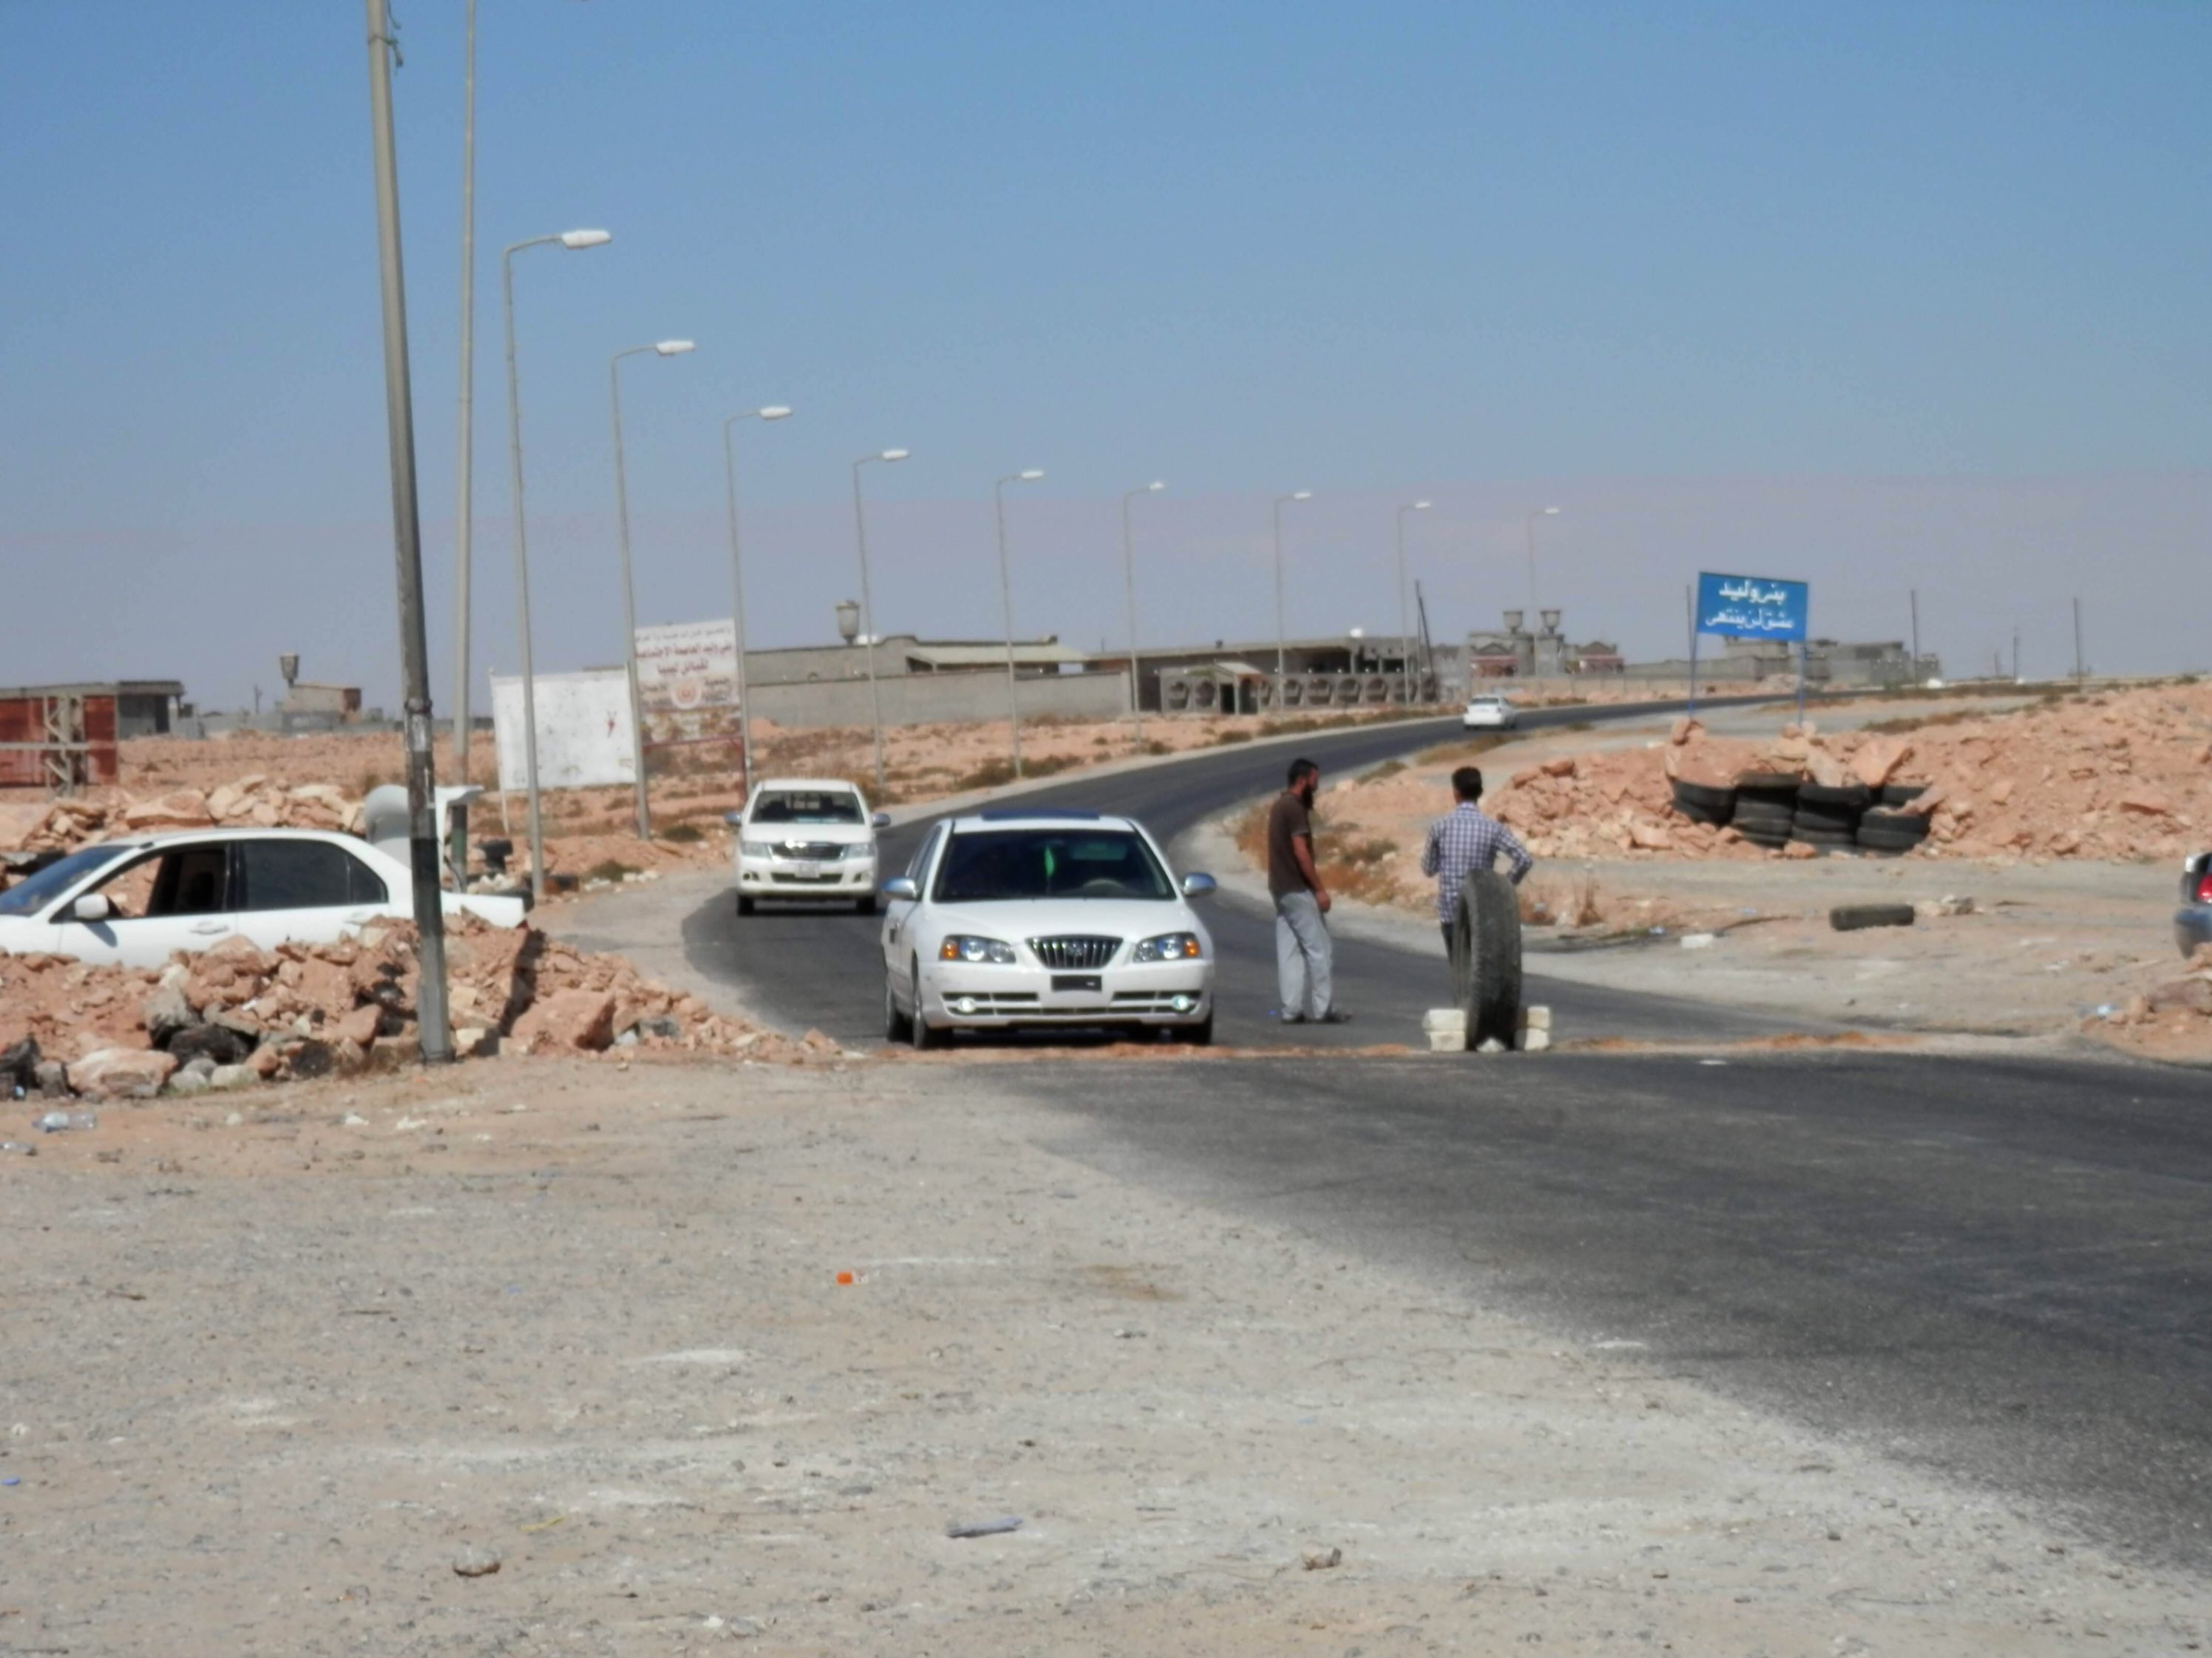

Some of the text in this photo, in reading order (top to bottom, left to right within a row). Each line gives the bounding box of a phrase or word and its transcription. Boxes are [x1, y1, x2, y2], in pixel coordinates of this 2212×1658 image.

[1719, 580, 1758, 603] وليد
[1744, 608, 1763, 629] لن
[1761, 611, 1794, 631] عشق
